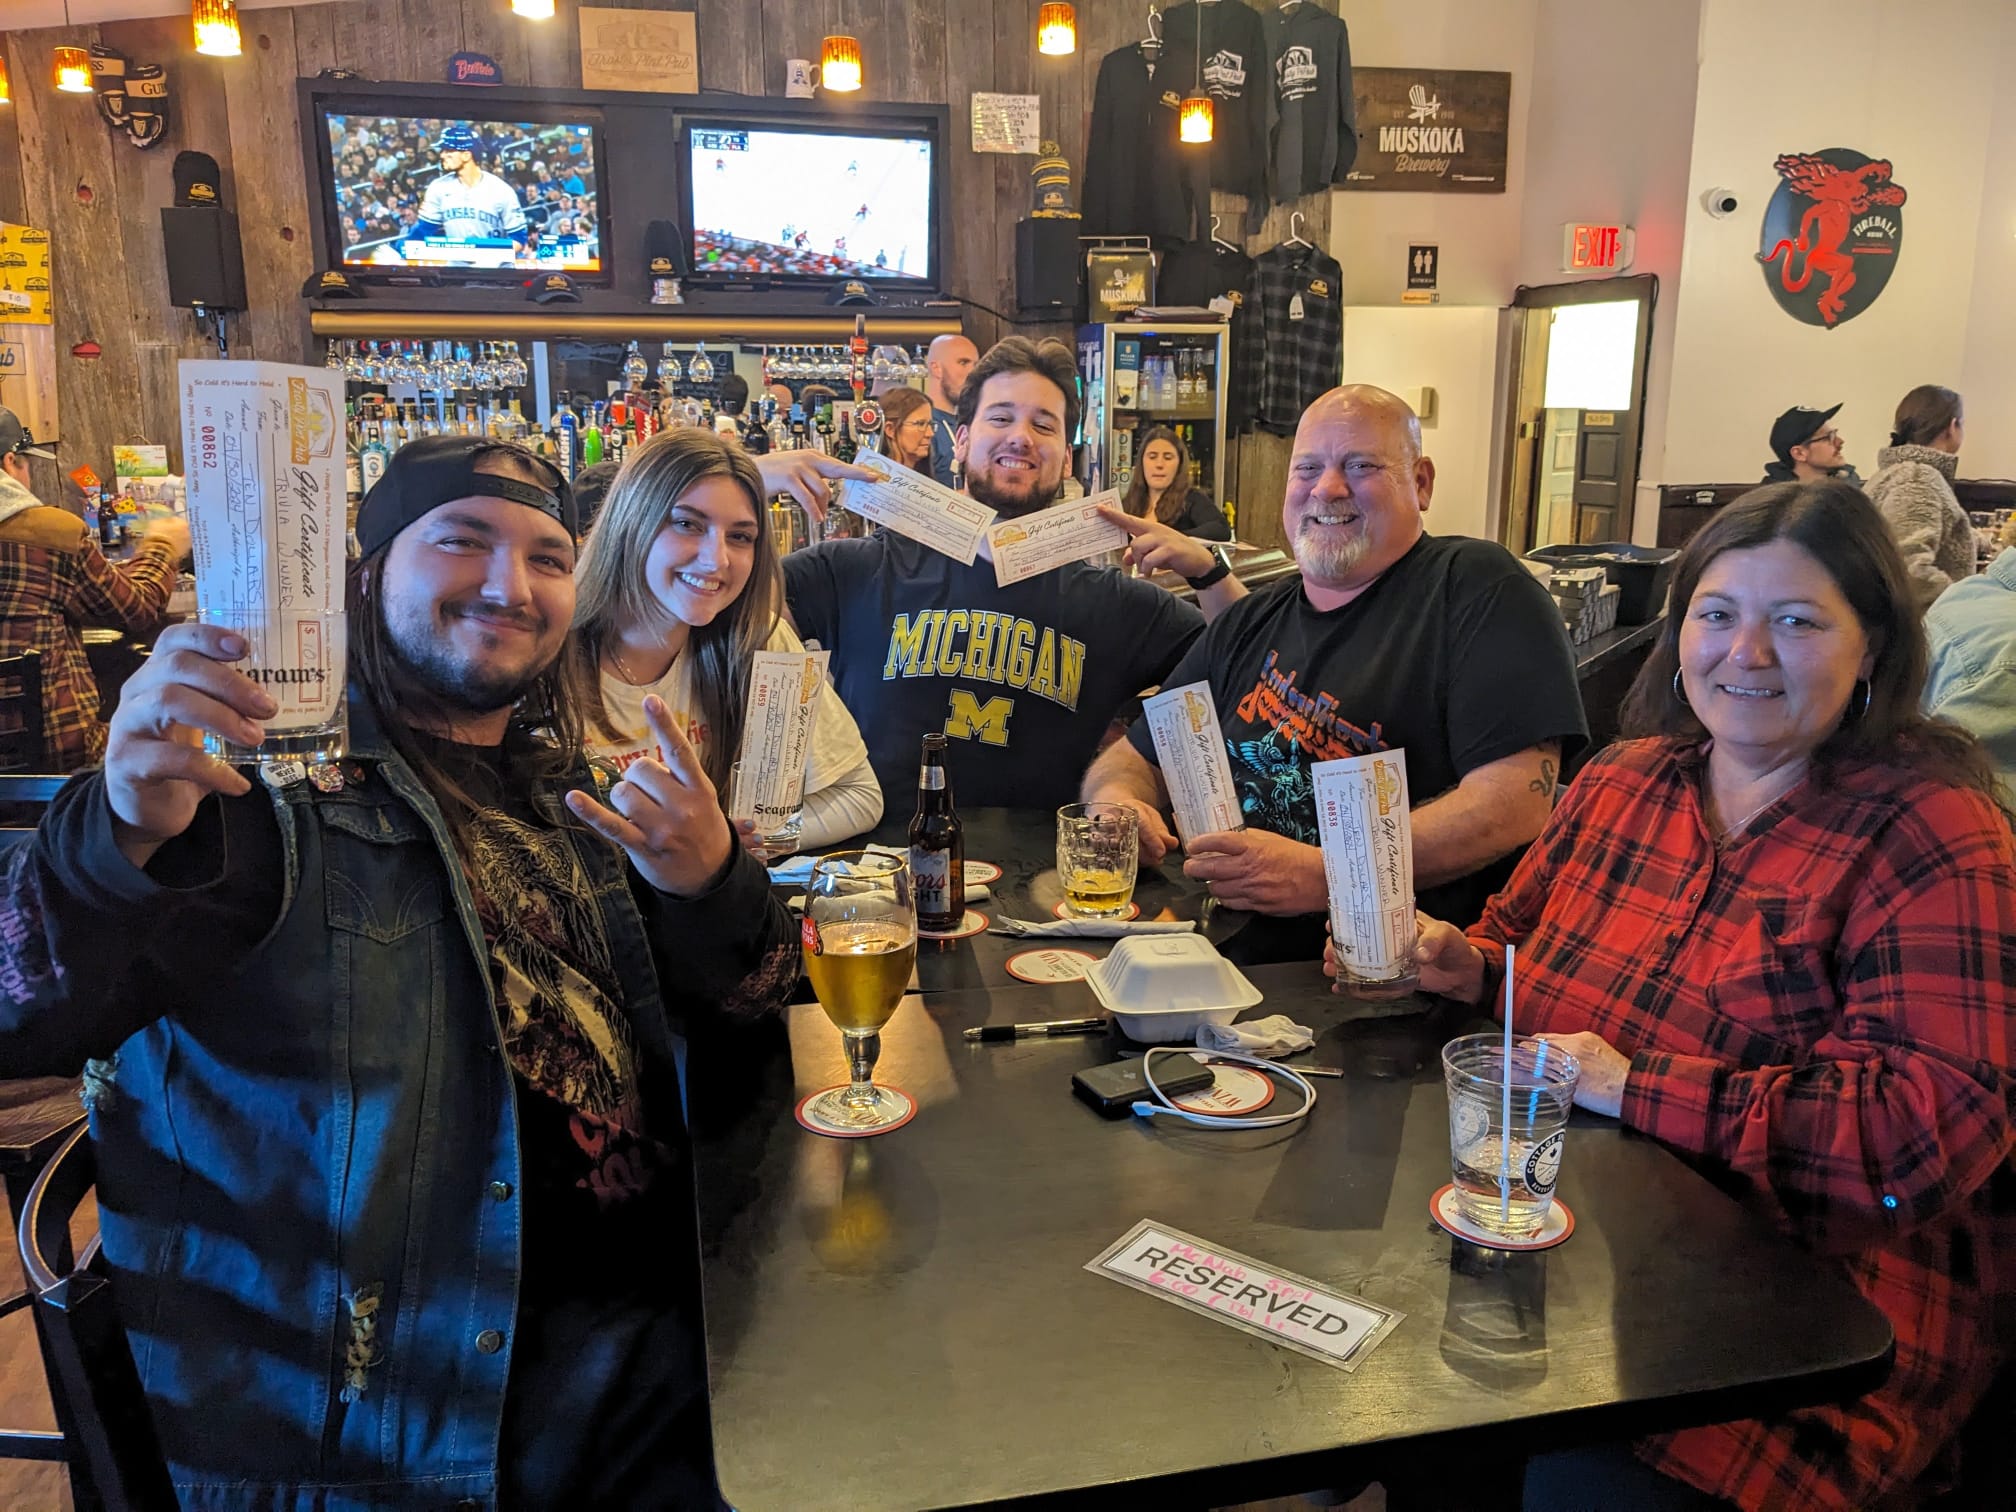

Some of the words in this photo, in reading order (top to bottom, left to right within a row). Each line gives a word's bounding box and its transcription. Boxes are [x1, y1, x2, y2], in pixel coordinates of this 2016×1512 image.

[1379, 126, 1464, 153] MUSKOKA
[1395, 154, 1451, 178] Brewery
[1572, 225, 1619, 267] EXIT
[1853, 216, 1897, 239] FIREBALL
[1100, 289, 1146, 302] MUSKOKA
[291, 379, 306, 414] Frosty
[201, 425, 218, 469] 00862
[294, 441, 308, 463] Pub
[560, 427, 571, 467] LIGHT
[243, 462, 256, 506] TEN
[275, 468, 292, 525] TRIVIA
[291, 466, 319, 511] Gift
[890, 476, 908, 489] Gift
[908, 484, 942, 503] Certificate
[1028, 524, 1044, 538] Gift
[1043, 516, 1076, 531] Certificate
[246, 515, 263, 605] DOLLARS
[293, 514, 319, 599] Certificate
[278, 540, 295, 612] WINNER
[303, 626, 315, 635] $
[883, 609, 1086, 712] MICHIGAN
[757, 684, 768, 708] 00859
[799, 705, 810, 728] Gift
[944, 688, 1014, 747] M
[792, 727, 806, 772] Certificate
[1195, 734, 1210, 755] Gift
[275, 767, 296, 778] NEVER
[1201, 754, 1217, 795] Certificate
[1326, 800, 1338, 828] 00838
[1379, 817, 1396, 842] Gift
[1385, 842, 1399, 896] Certificate
[1526, 1136, 1556, 1174] COTTAGE
[1134, 1246, 1349, 1336] RESERVED
